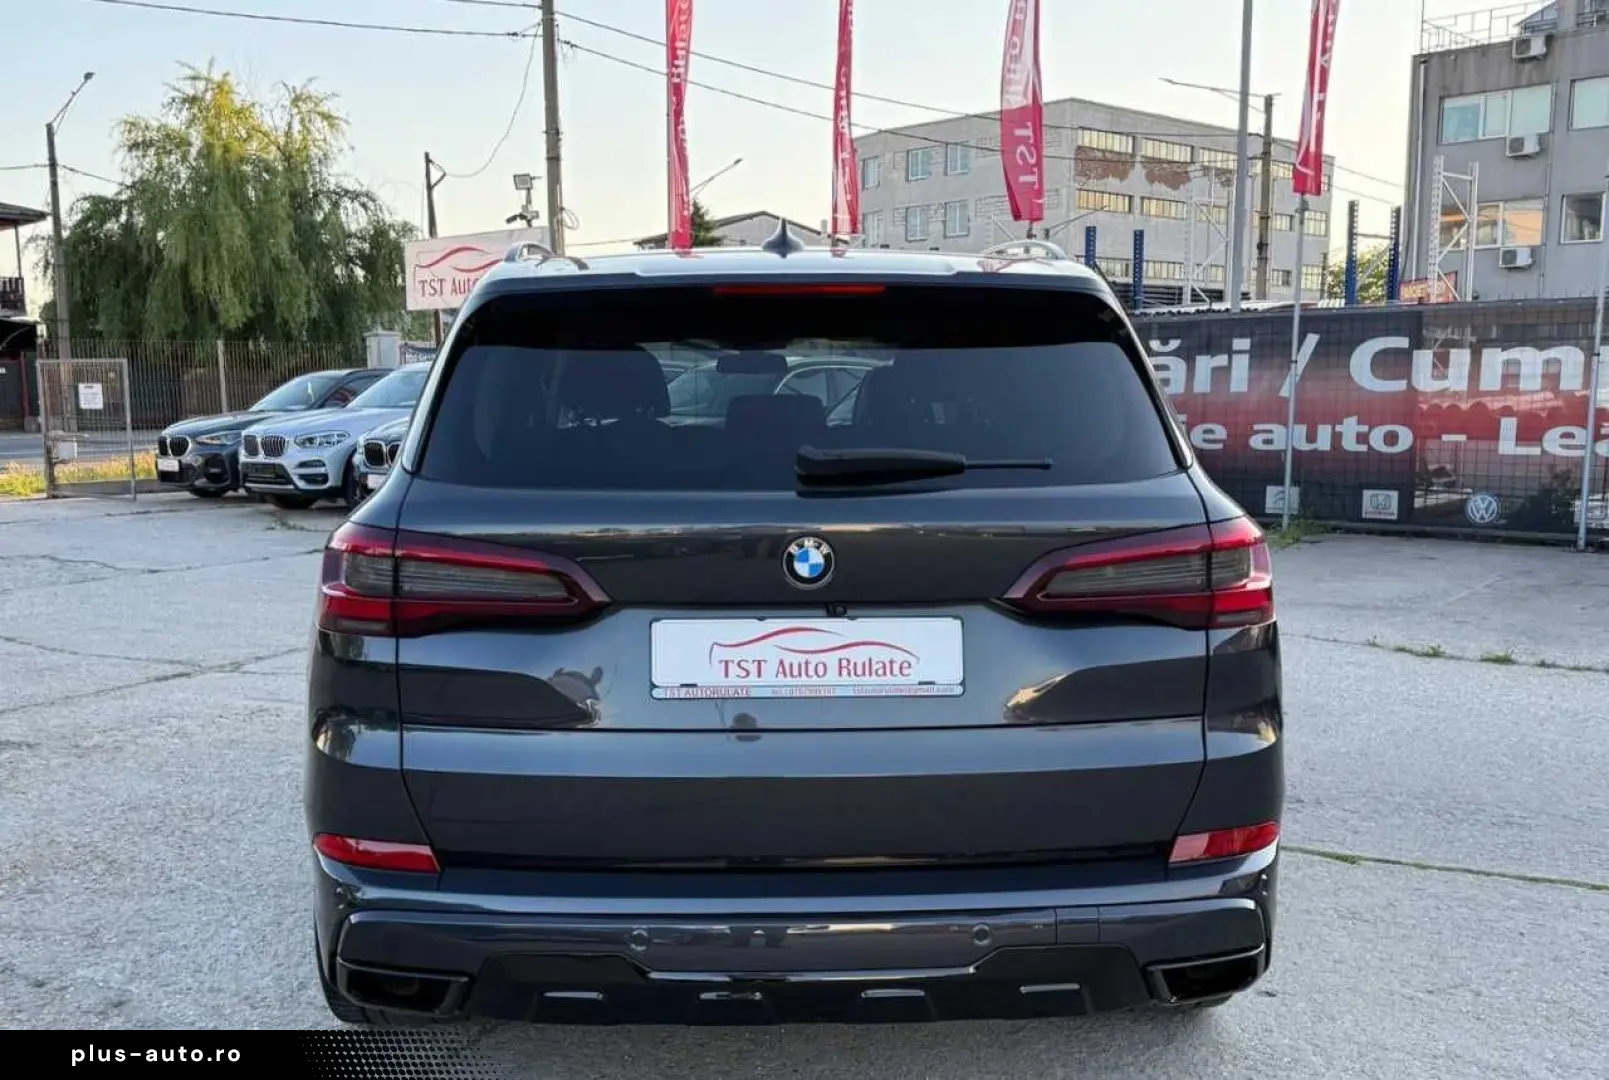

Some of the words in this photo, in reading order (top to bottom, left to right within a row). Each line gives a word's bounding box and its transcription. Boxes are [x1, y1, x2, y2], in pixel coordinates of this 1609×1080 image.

[418, 276, 446, 298] TST
[1248, 416, 1413, 453] auto
[718, 659, 767, 679] TST
[775, 658, 827, 679] Auto
[838, 657, 912, 677] Rulate
